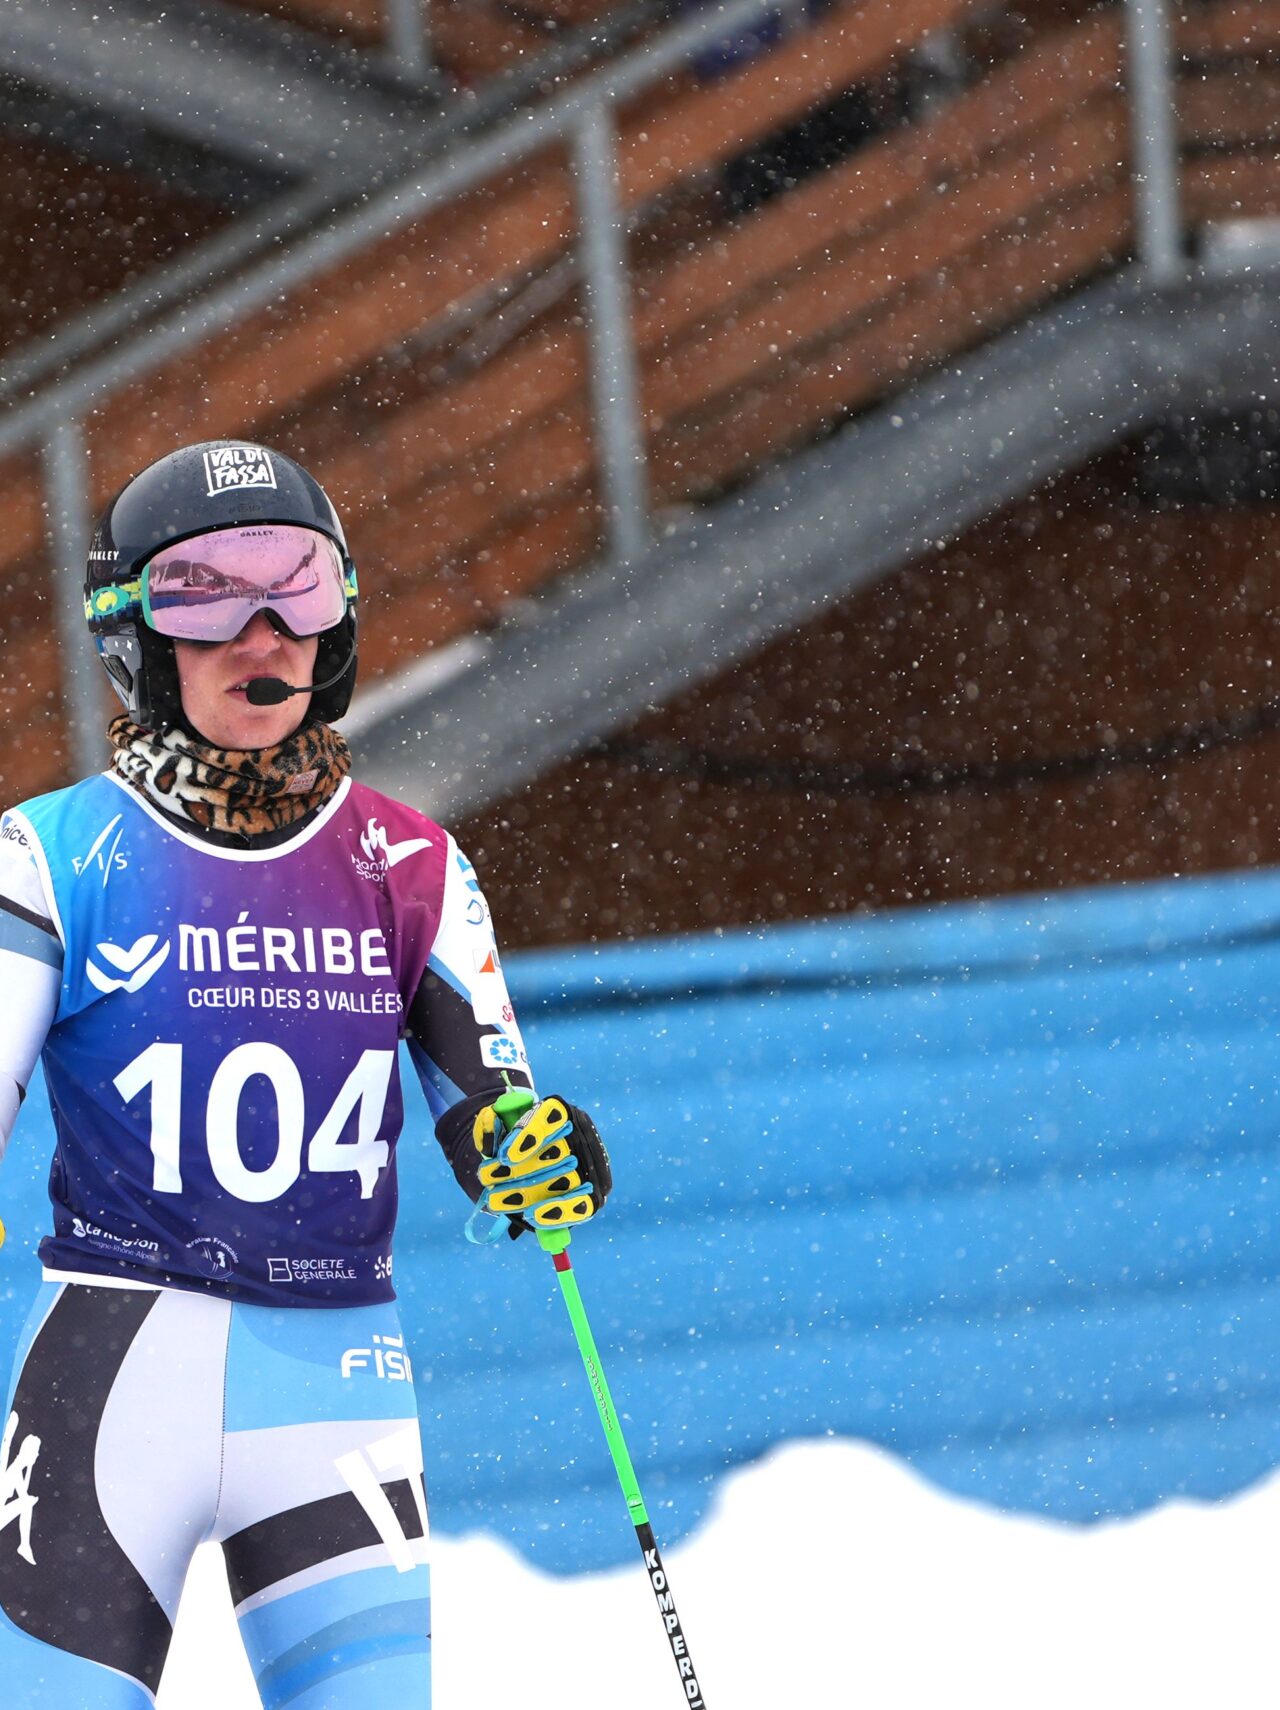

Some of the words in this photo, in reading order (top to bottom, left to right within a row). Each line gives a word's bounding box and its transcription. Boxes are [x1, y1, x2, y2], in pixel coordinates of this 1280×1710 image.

[210, 449, 244, 467] VAL
[213, 463, 270, 488] FASSA
[240, 530, 274, 538] OAKLEY
[356, 864, 386, 883] Spor
[188, 987, 255, 1009] CŒUR
[261, 987, 301, 1010] DES
[306, 989, 320, 1011] 3
[324, 988, 404, 1015] VALLÉES
[112, 1041, 395, 1204] 104
[86, 1223, 102, 1236] La
[291, 1259, 345, 1271] SOCIETE
[294, 1269, 357, 1281] GENERALE
